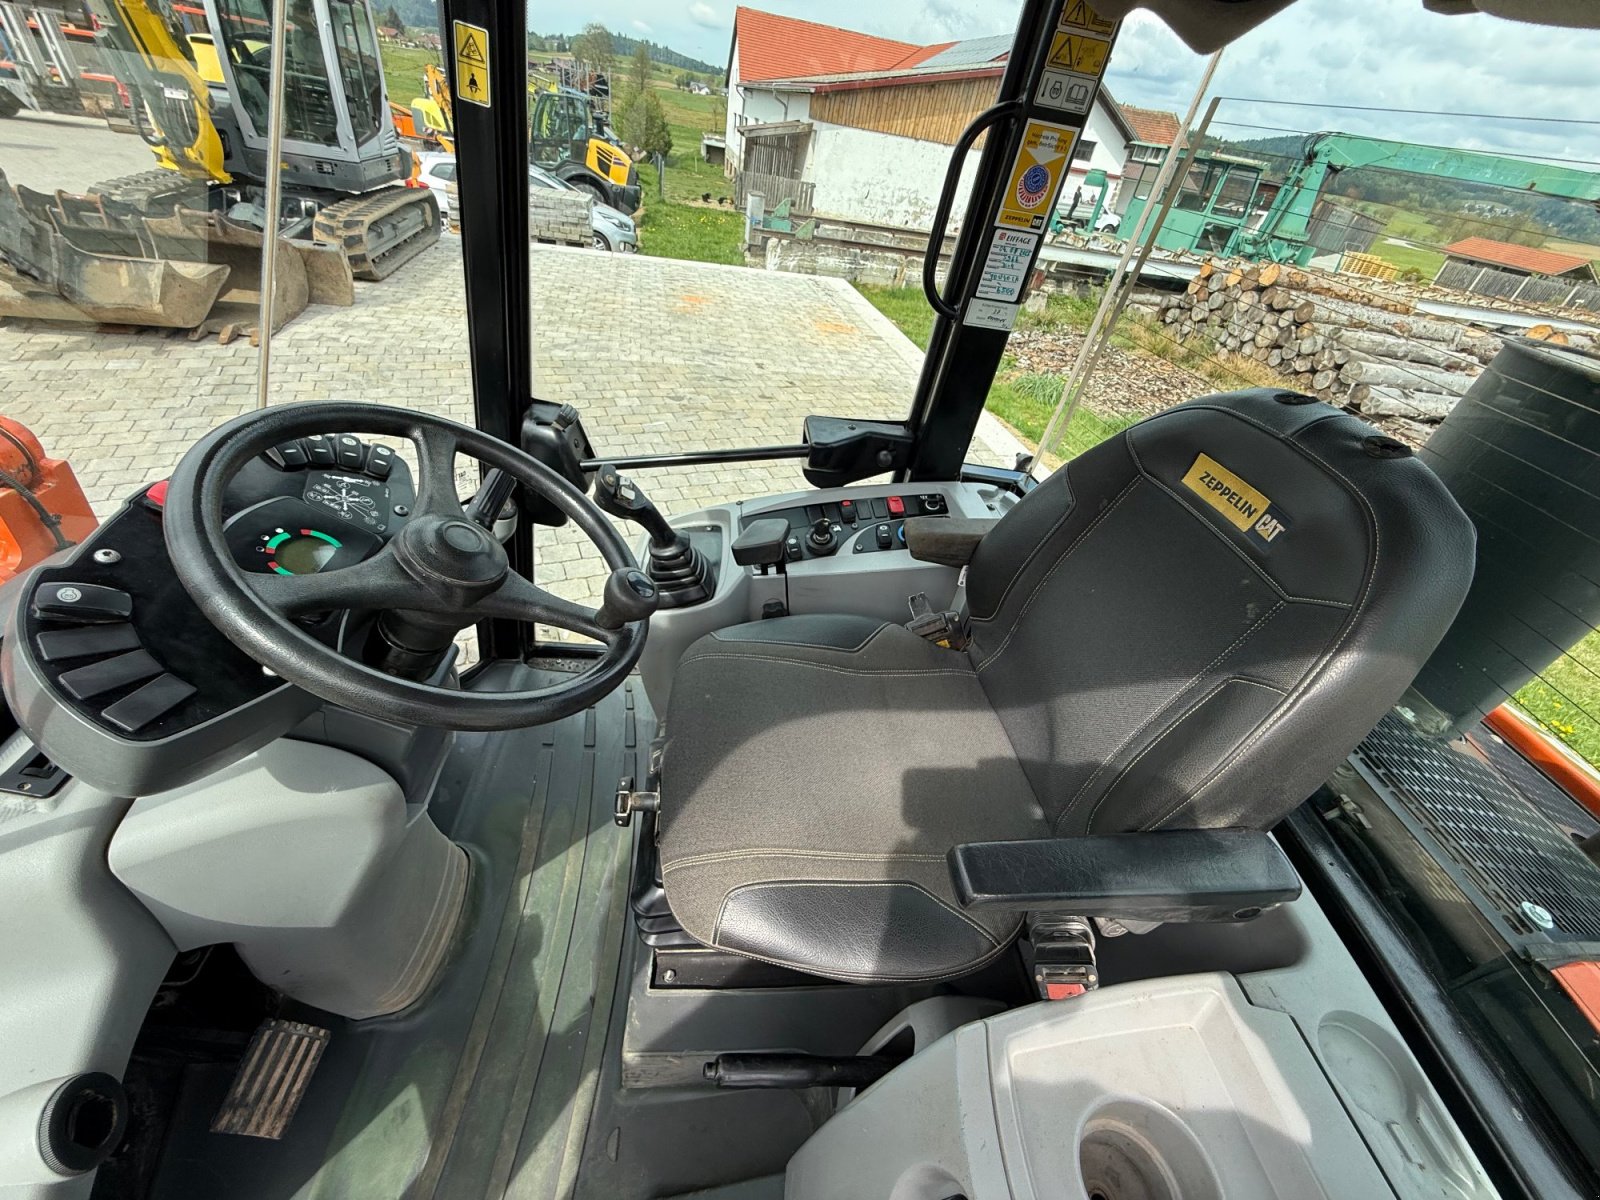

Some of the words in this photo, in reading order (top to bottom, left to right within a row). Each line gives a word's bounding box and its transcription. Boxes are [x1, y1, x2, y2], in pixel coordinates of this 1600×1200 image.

[1004, 214, 1031, 224] ZEPPELIN
[1006, 234, 1032, 245] EIFFAGE
[1199, 470, 1258, 519] ZEPPELIN
[1255, 513, 1286, 542] CAT
